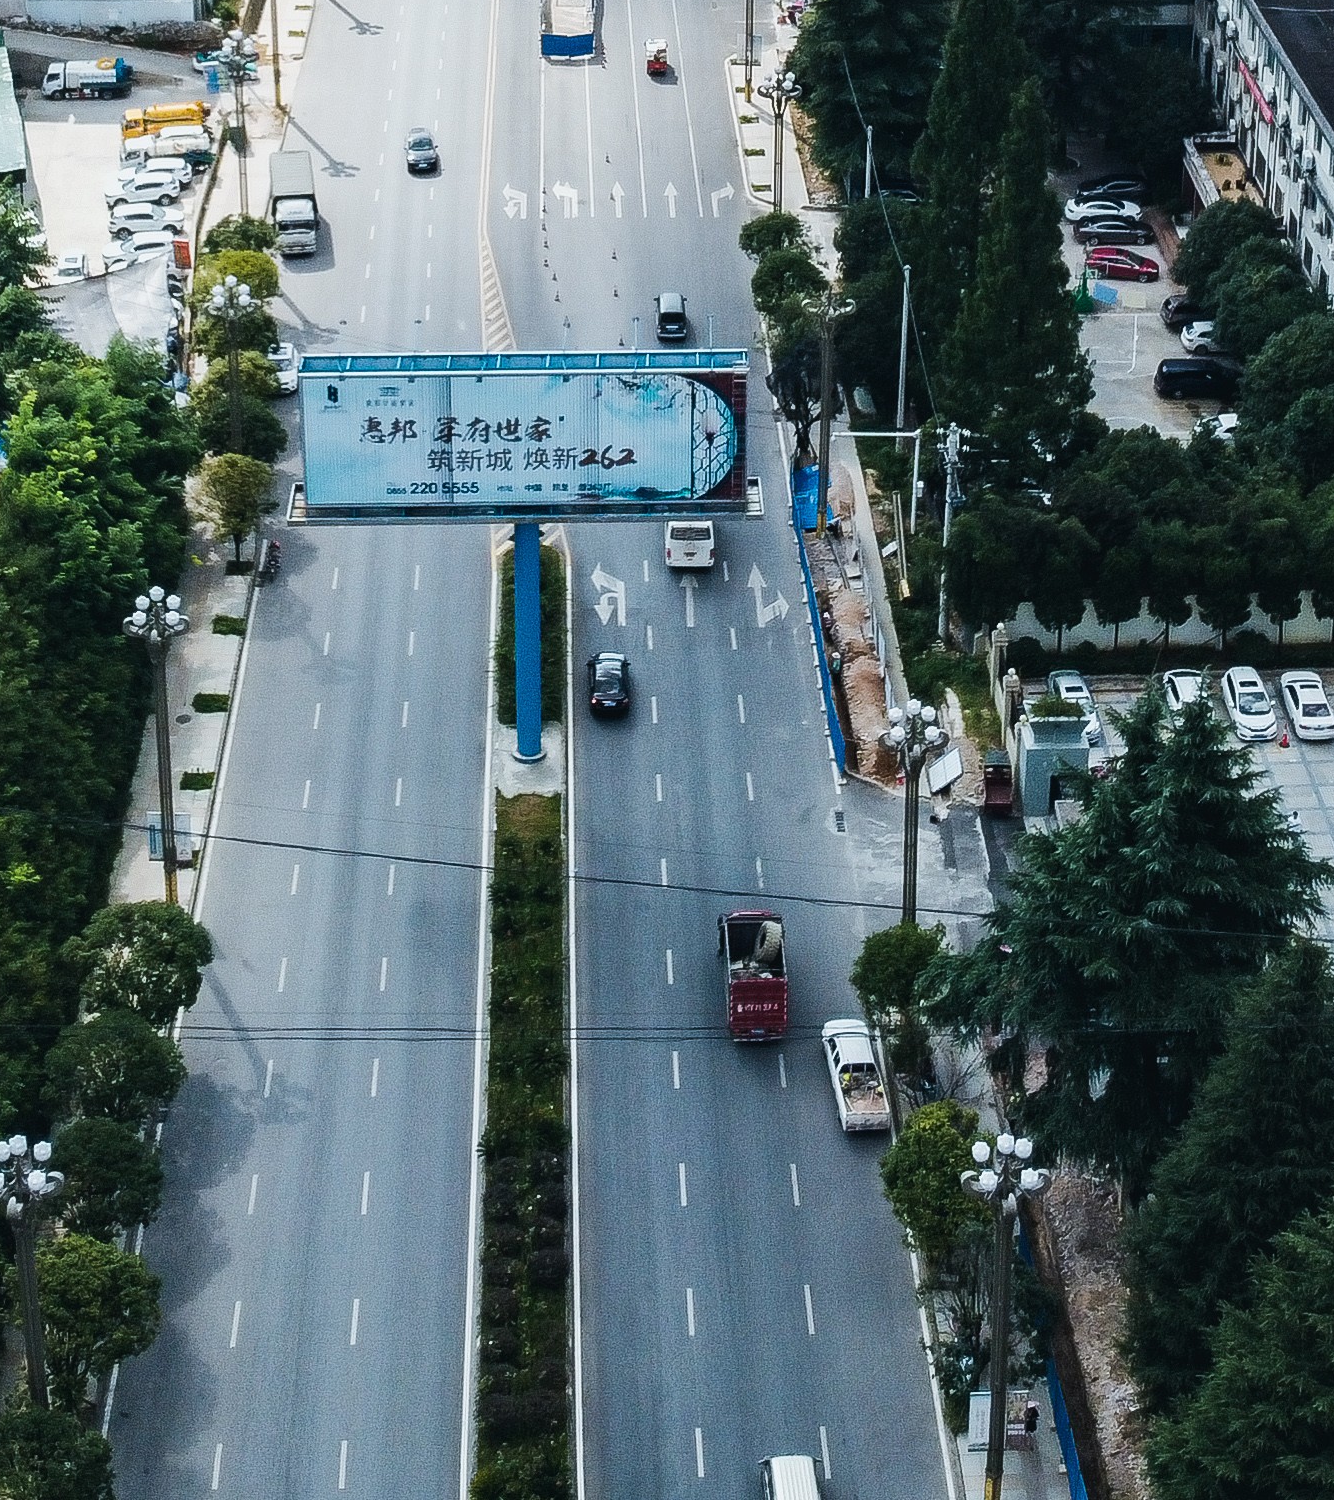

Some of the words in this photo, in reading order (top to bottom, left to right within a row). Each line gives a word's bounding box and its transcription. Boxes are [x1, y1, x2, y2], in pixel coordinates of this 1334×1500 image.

[427, 448, 513, 472] 筑新城
[441, 482, 480, 494] 5555
